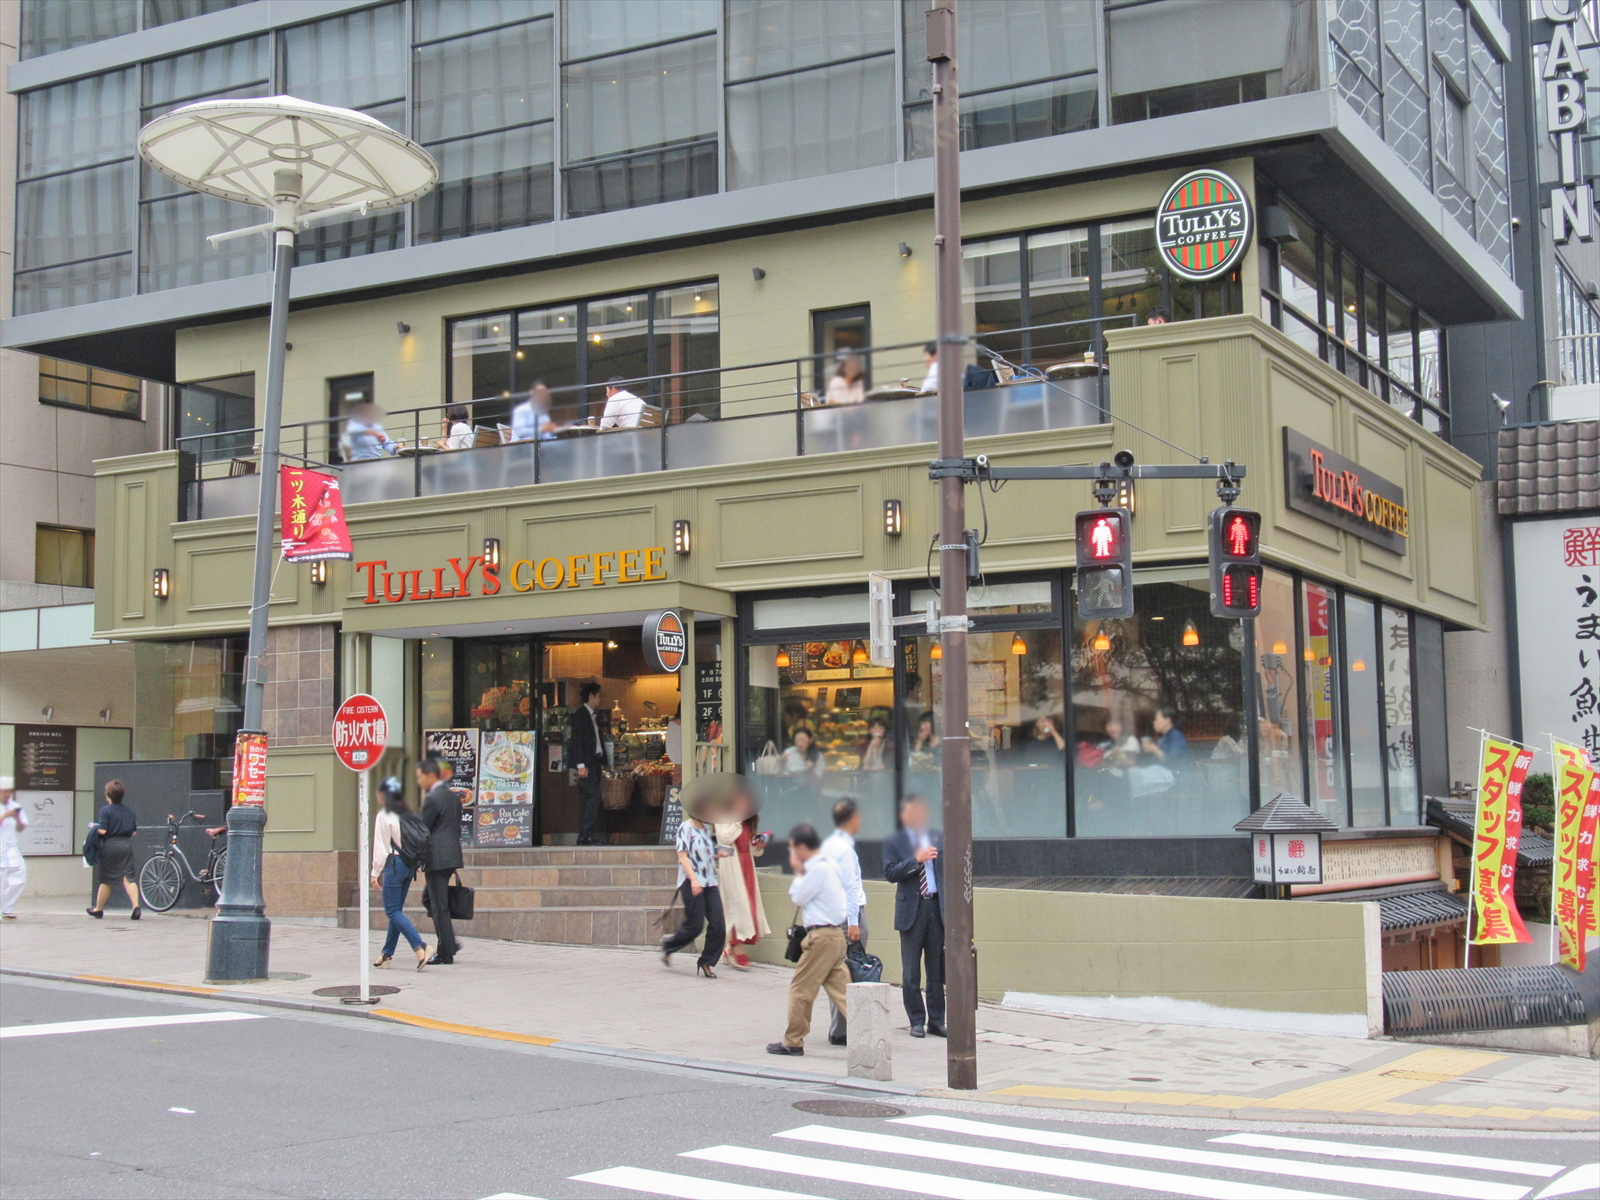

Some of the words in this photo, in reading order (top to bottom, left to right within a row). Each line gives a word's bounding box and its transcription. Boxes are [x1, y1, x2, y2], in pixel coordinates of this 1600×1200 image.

[1163, 208, 1241, 236] TULLY'S
[1177, 230, 1227, 245] COFFEE
[1310, 448, 1364, 517] TULLY'S
[1364, 490, 1409, 538] COFFEE
[289, 472, 307, 539] 一ツ木通り
[356, 556, 500, 604] TULLY'S
[510, 548, 667, 592] COFFEE
[658, 633, 683, 647] TULLY'S
[703, 689, 712, 699] 1F
[343, 706, 354, 715] FIRE
[356, 705, 379, 714] CISTERN
[703, 707, 713, 716] 2F
[428, 734, 472, 750] Waffle
[248, 766, 266, 778] セー
[669, 787, 680, 803] S
[512, 808, 530, 817] Cake
[1500, 755, 1531, 895] 新鮮力求む！
[1476, 746, 1511, 940] スタッフ募集
